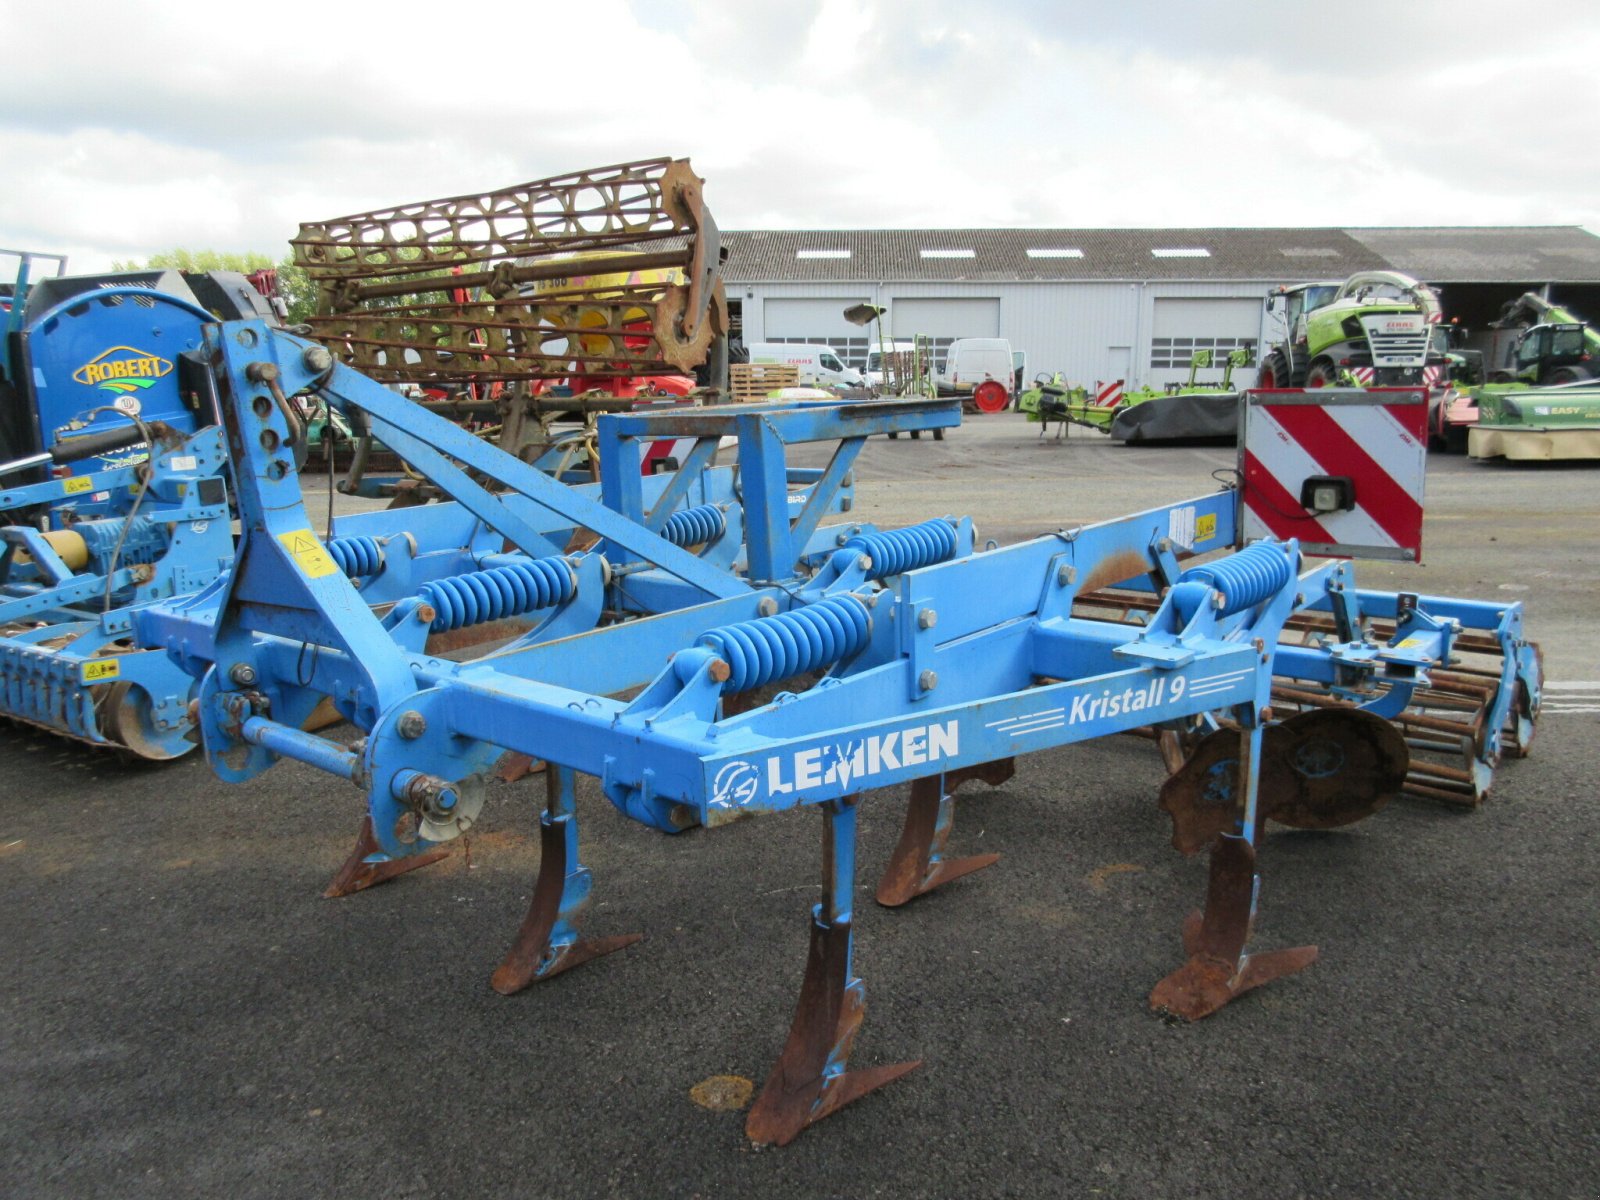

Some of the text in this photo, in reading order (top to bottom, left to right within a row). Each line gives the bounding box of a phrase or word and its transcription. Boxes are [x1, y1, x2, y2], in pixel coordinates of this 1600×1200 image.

[86, 357, 161, 385] ROBERT
[1068, 675, 1186, 725] Kristall 9
[767, 719, 959, 797] LEMKEN
